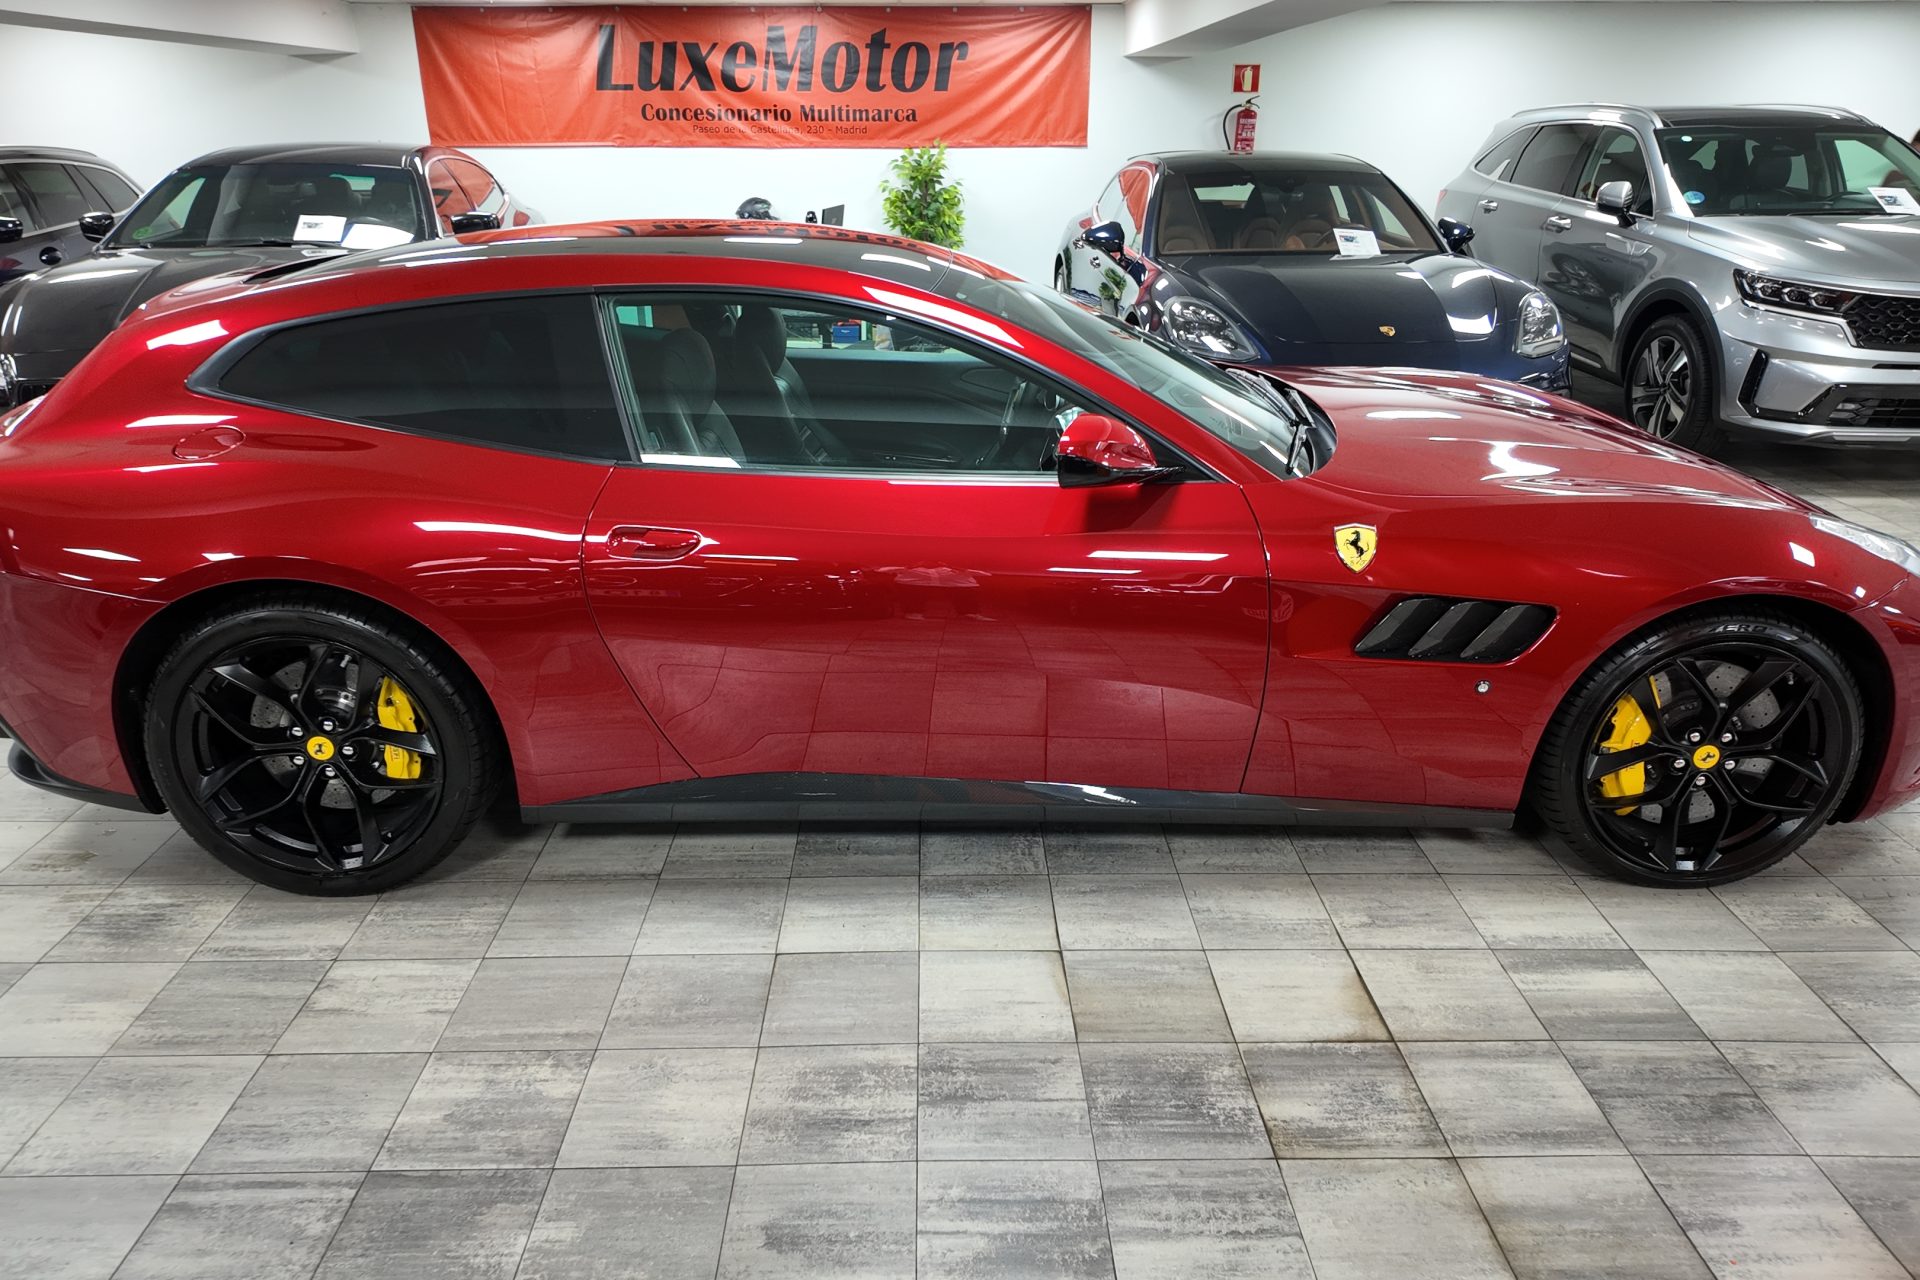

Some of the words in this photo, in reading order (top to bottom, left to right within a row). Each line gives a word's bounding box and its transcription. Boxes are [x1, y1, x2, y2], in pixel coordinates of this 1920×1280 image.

[596, 24, 969, 93] LuxeMotor
[641, 103, 792, 122] Concesionario
[800, 104, 918, 122] Multimarca
[692, 125, 720, 134] Paseo
[723, 124, 736, 134] de
[806, 125, 825, 134] 230
[836, 125, 868, 134] Madrid
